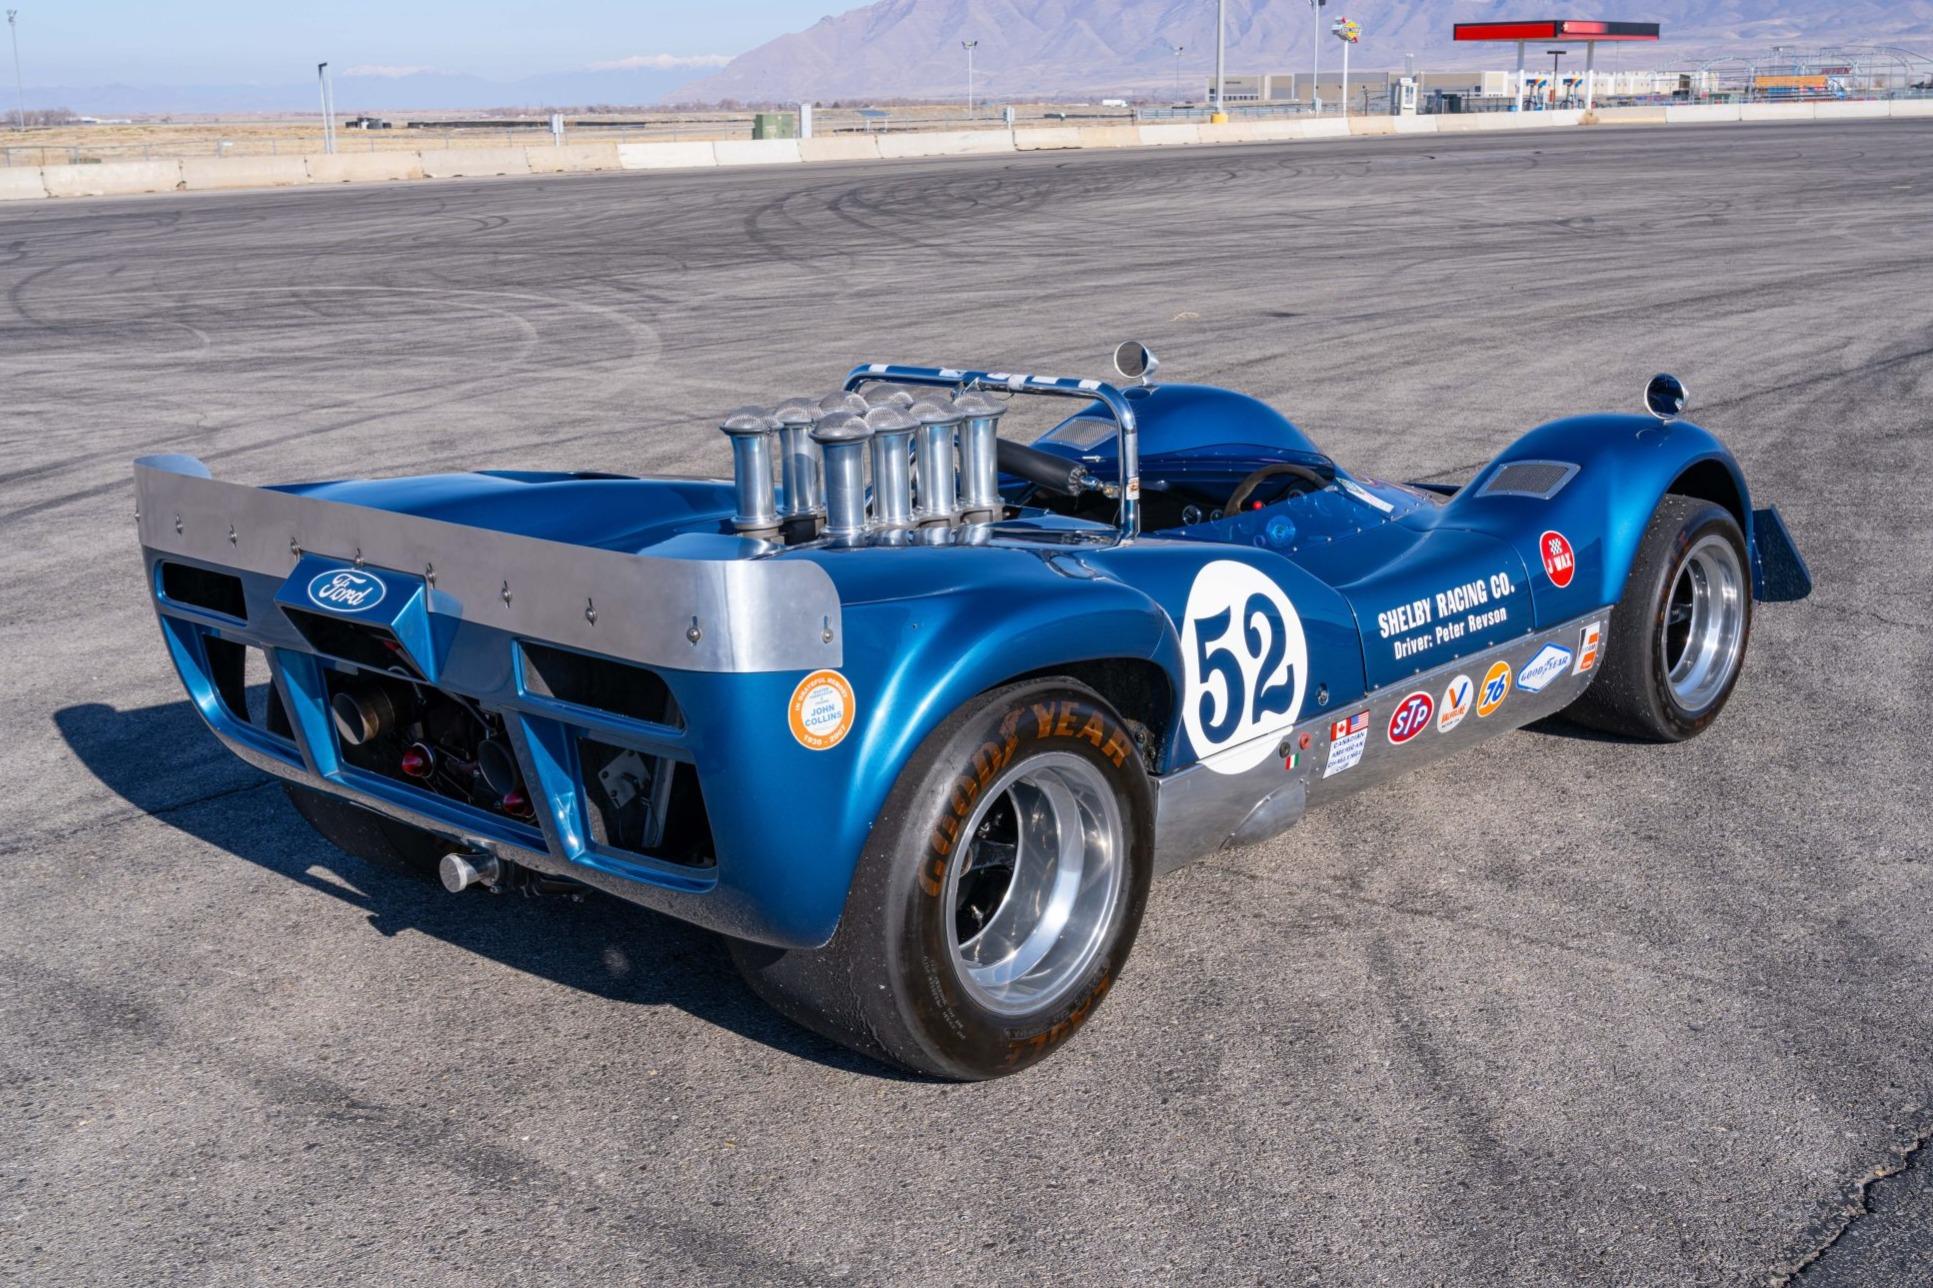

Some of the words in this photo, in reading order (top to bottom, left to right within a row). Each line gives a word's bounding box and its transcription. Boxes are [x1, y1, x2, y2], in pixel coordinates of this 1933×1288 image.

[1547, 558, 1554, 574] J
[1553, 552, 1573, 571] WAX
[319, 573, 373, 606] Ford
[1378, 597, 1433, 639] SHELBY
[1436, 579, 1488, 619] RACING
[1490, 571, 1515, 600] CO.
[1394, 634, 1433, 660] Driver:
[1435, 620, 1465, 645] Peter
[1468, 607, 1507, 633] Revson
[1194, 592, 1295, 744] 52
[1482, 674, 1507, 706] 76
[805, 710, 842, 726] COLLINS
[811, 703, 835, 717] JOHN
[1392, 699, 1428, 735] STP
